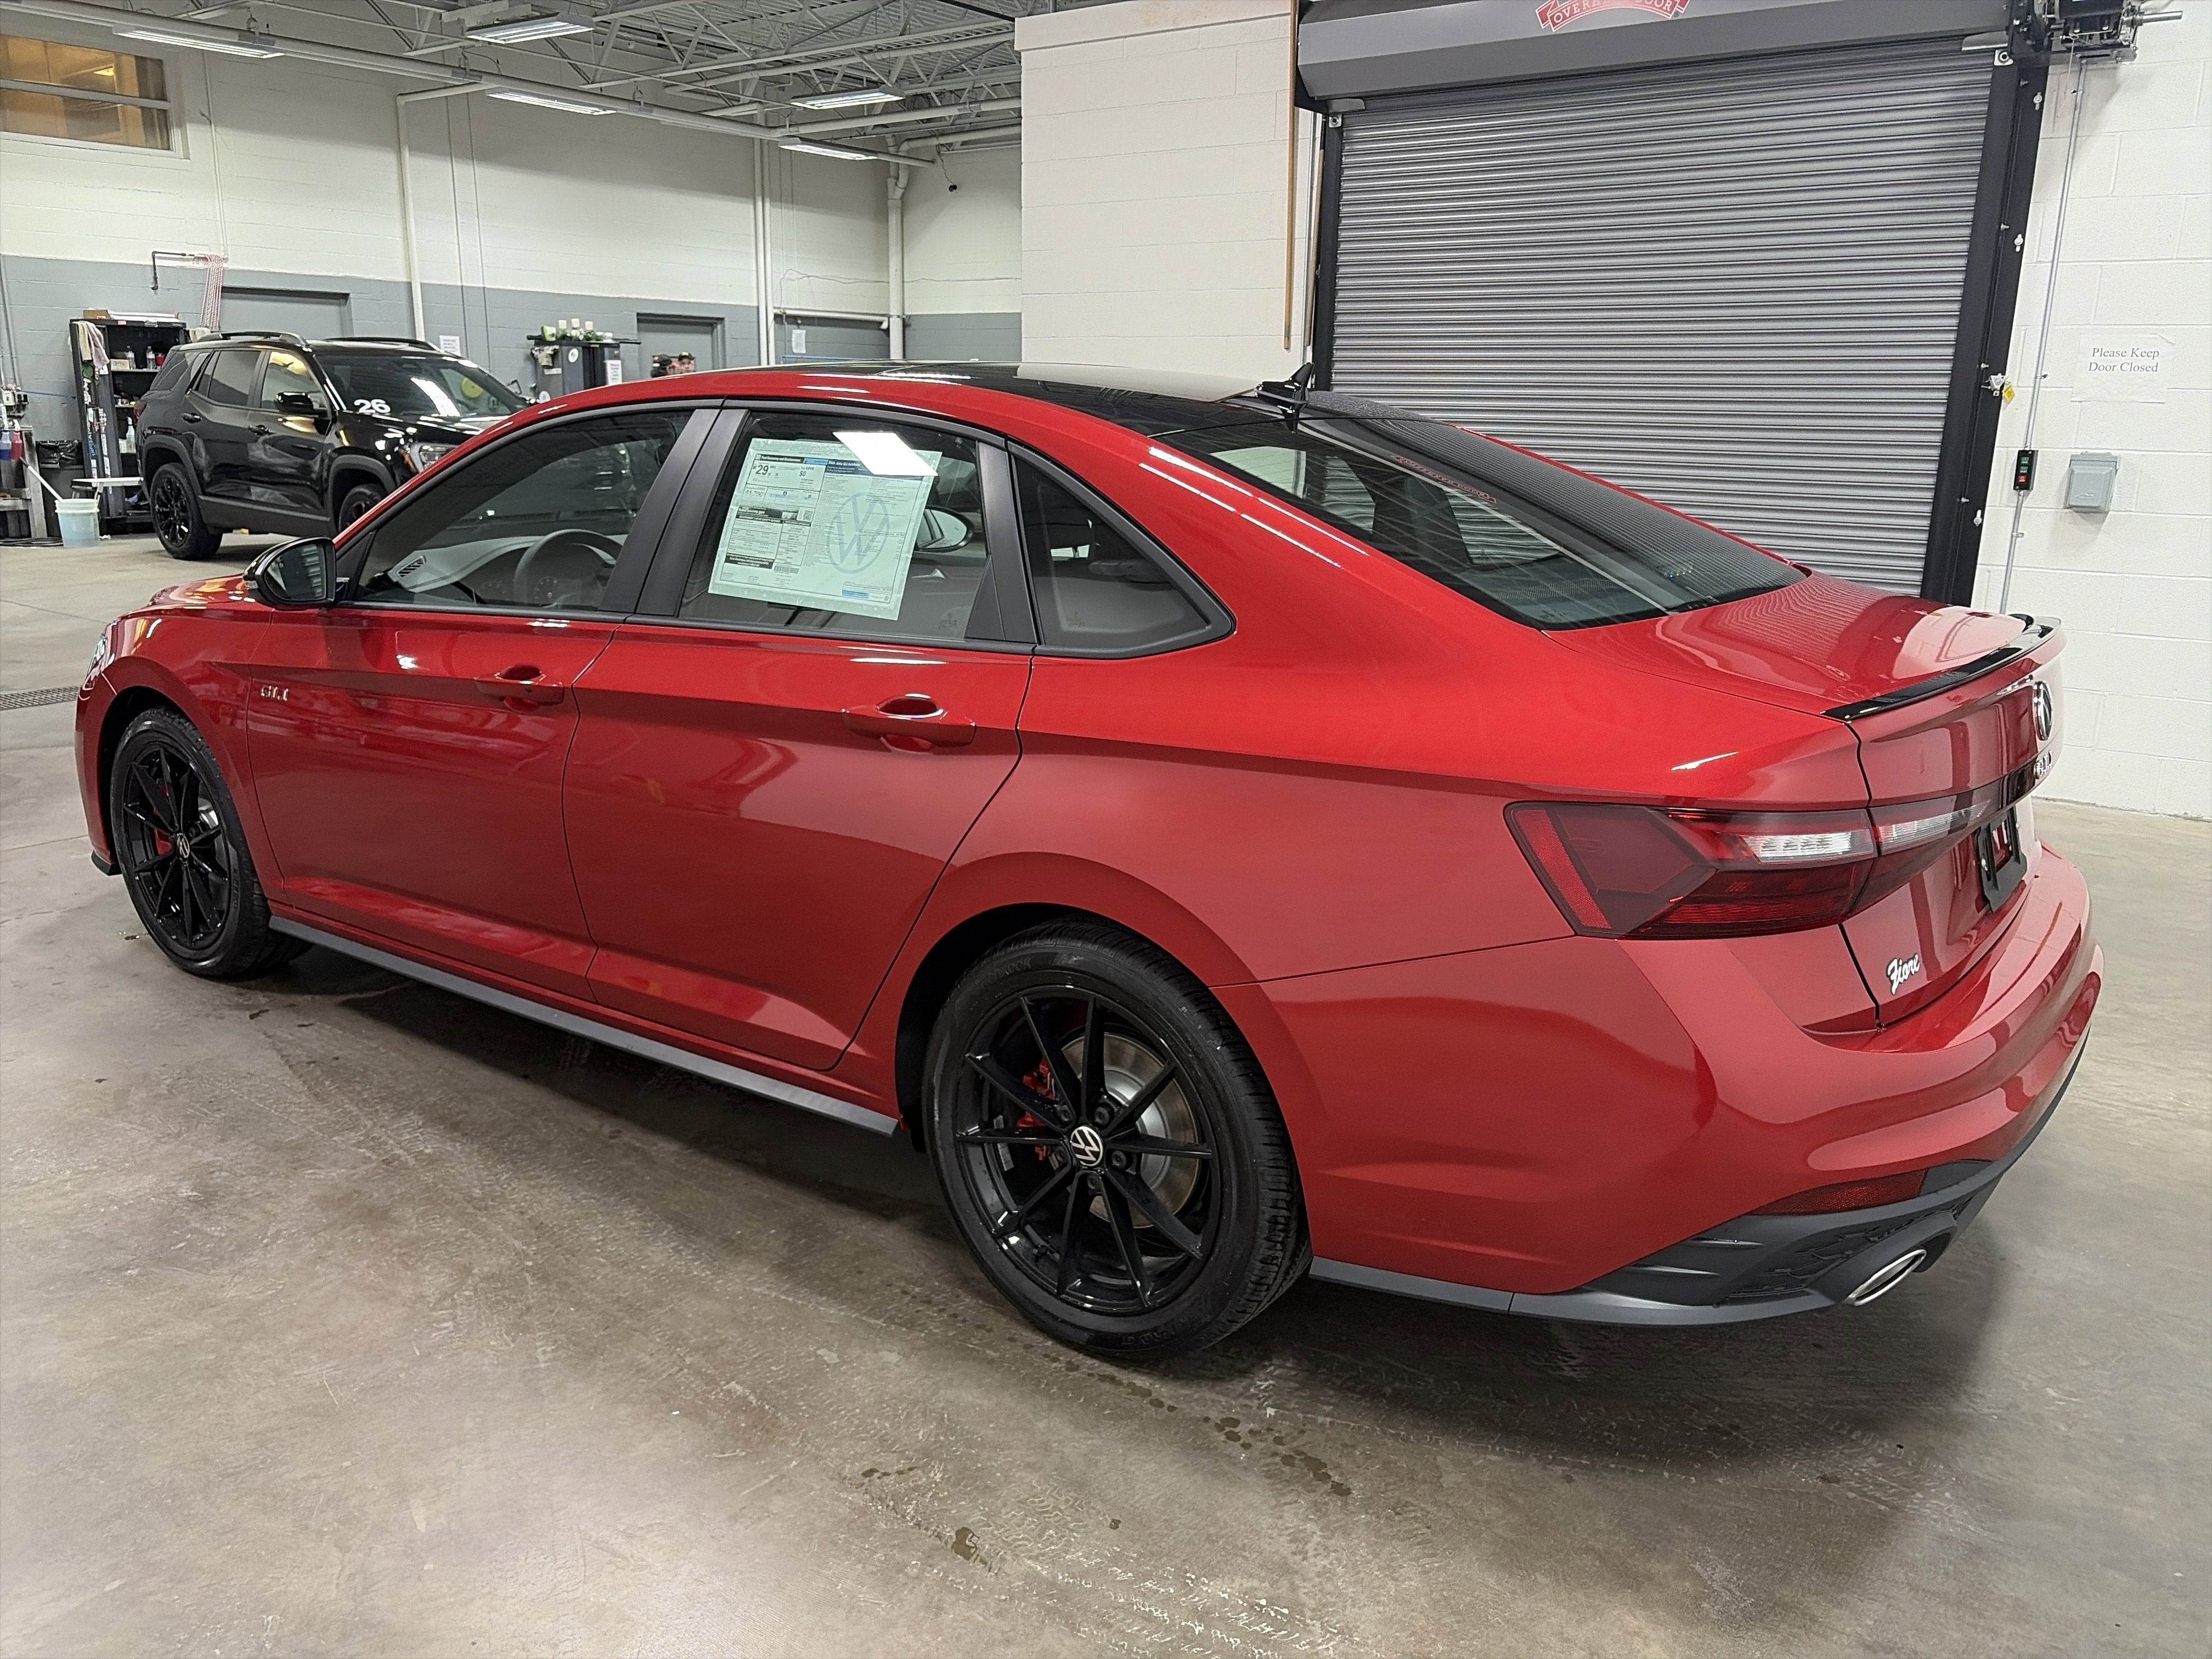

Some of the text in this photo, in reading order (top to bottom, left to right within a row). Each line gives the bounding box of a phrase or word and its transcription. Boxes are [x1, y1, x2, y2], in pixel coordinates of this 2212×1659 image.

[2091, 347, 2159, 360] Please Keep
[2089, 362, 2159, 372] Door Closed
[354, 399, 391, 413] 26
[755, 465, 769, 475] 29
[1886, 953, 1920, 995] Fiore
